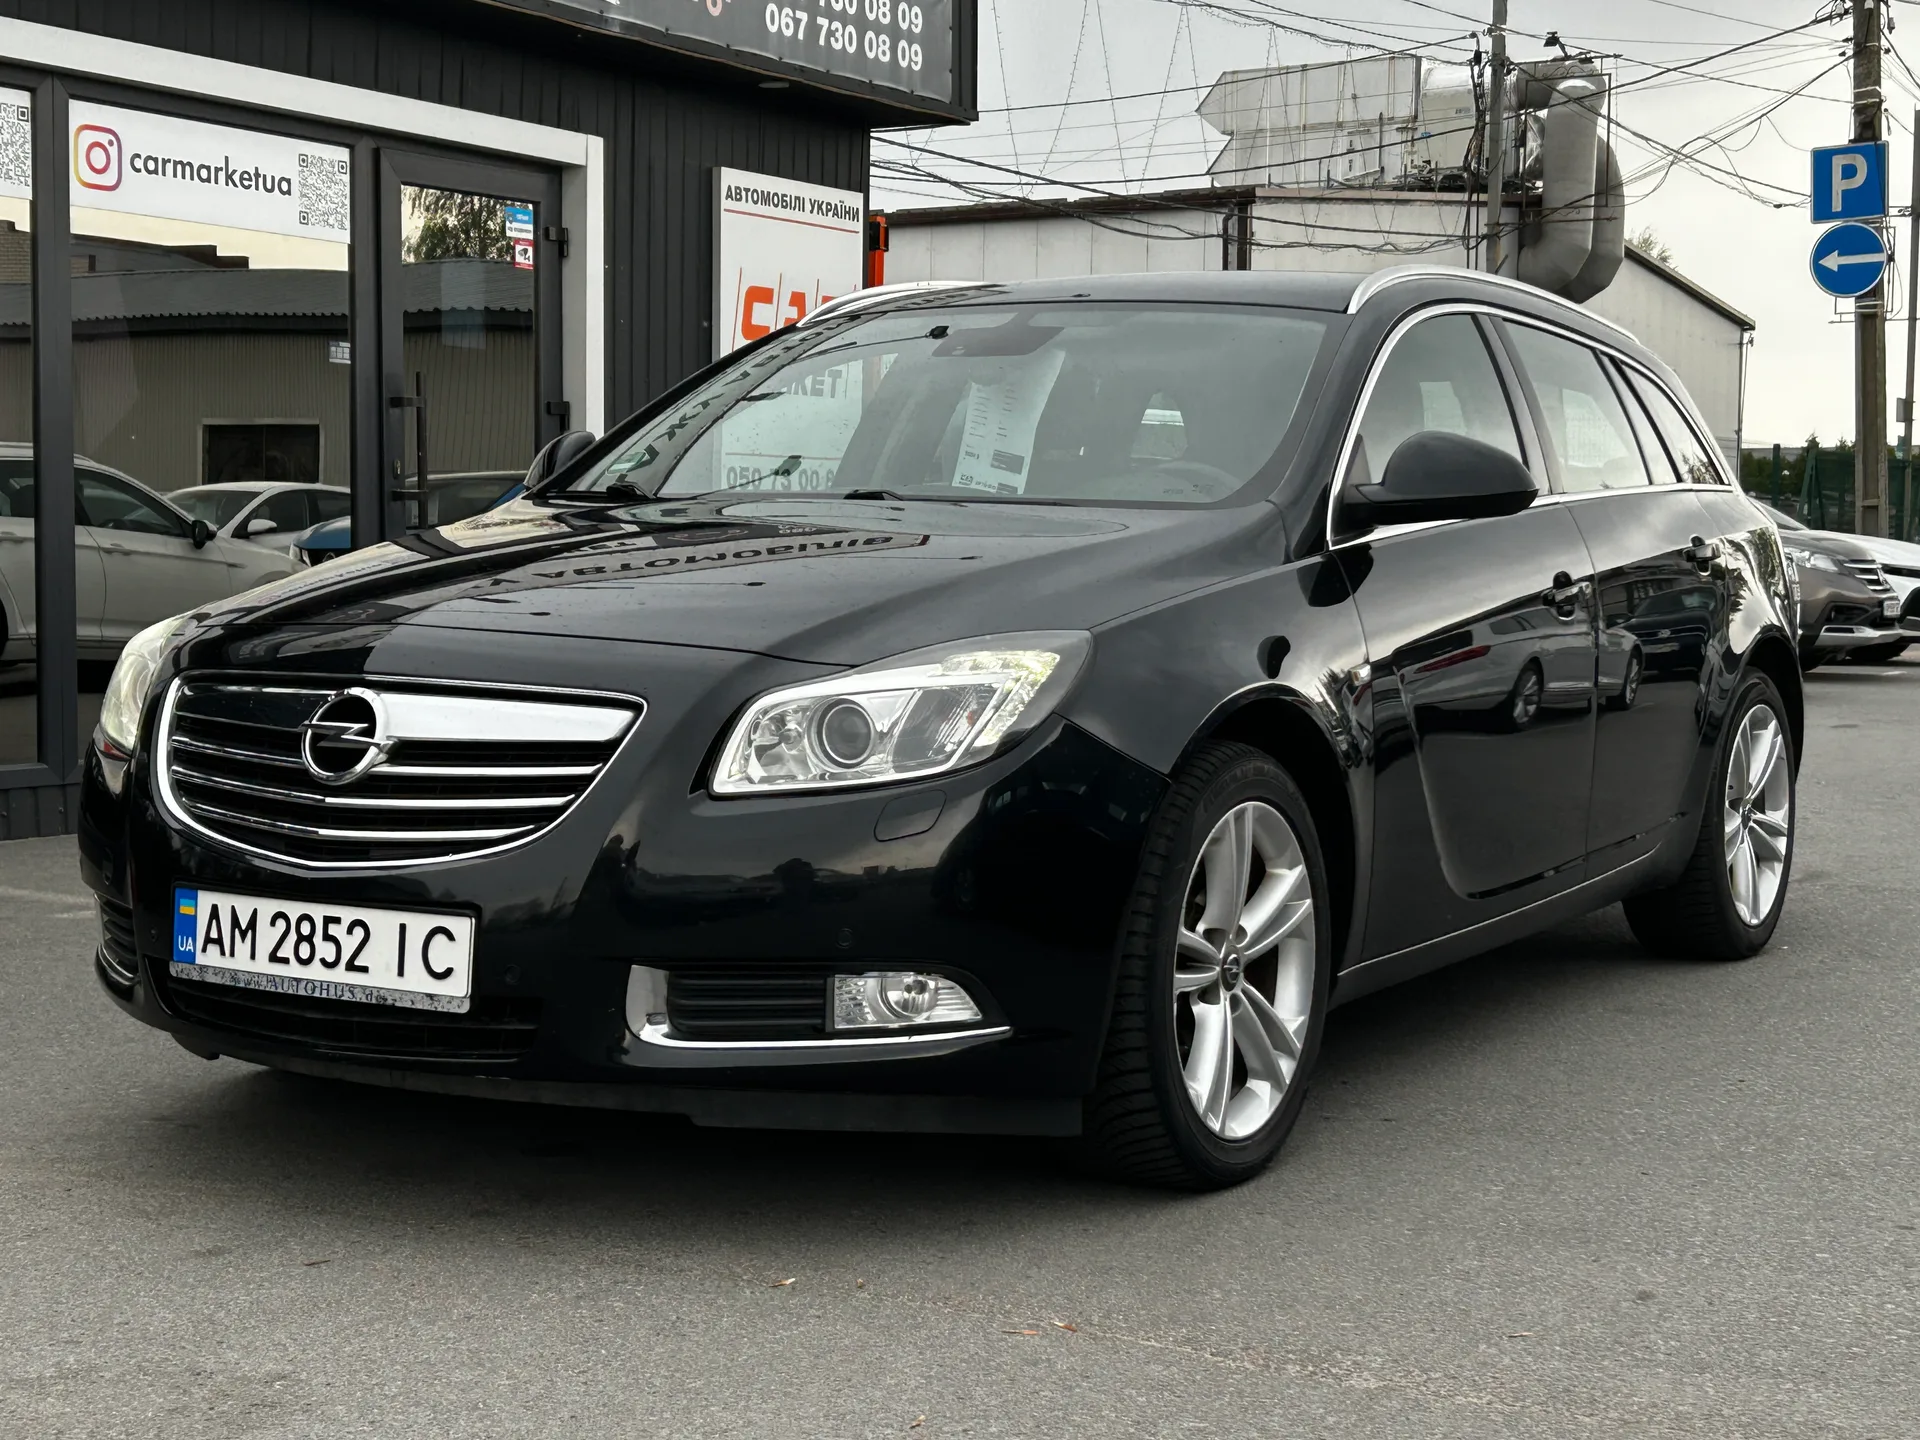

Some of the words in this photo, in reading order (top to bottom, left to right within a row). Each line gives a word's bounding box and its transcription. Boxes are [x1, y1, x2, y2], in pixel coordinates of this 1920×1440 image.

[765, 3, 808, 41] 067
[816, 16, 857, 54] 730
[864, 30, 890, 62] 08
[897, 39, 923, 71] 09
[897, 2, 923, 34] 09
[129, 152, 292, 197] carmarketua
[1832, 153, 1868, 212] P
[725, 184, 805, 212] АВТОМОБІЛІ
[809, 198, 860, 223] УКРАЇНИ
[742, 285, 837, 340] CA
[726, 466, 761, 491] 050
[798, 468, 820, 491] 00
[178, 935, 194, 953] UA
[201, 903, 258, 961] AM
[268, 911, 370, 973] 2852
[397, 922, 456, 980] IC
